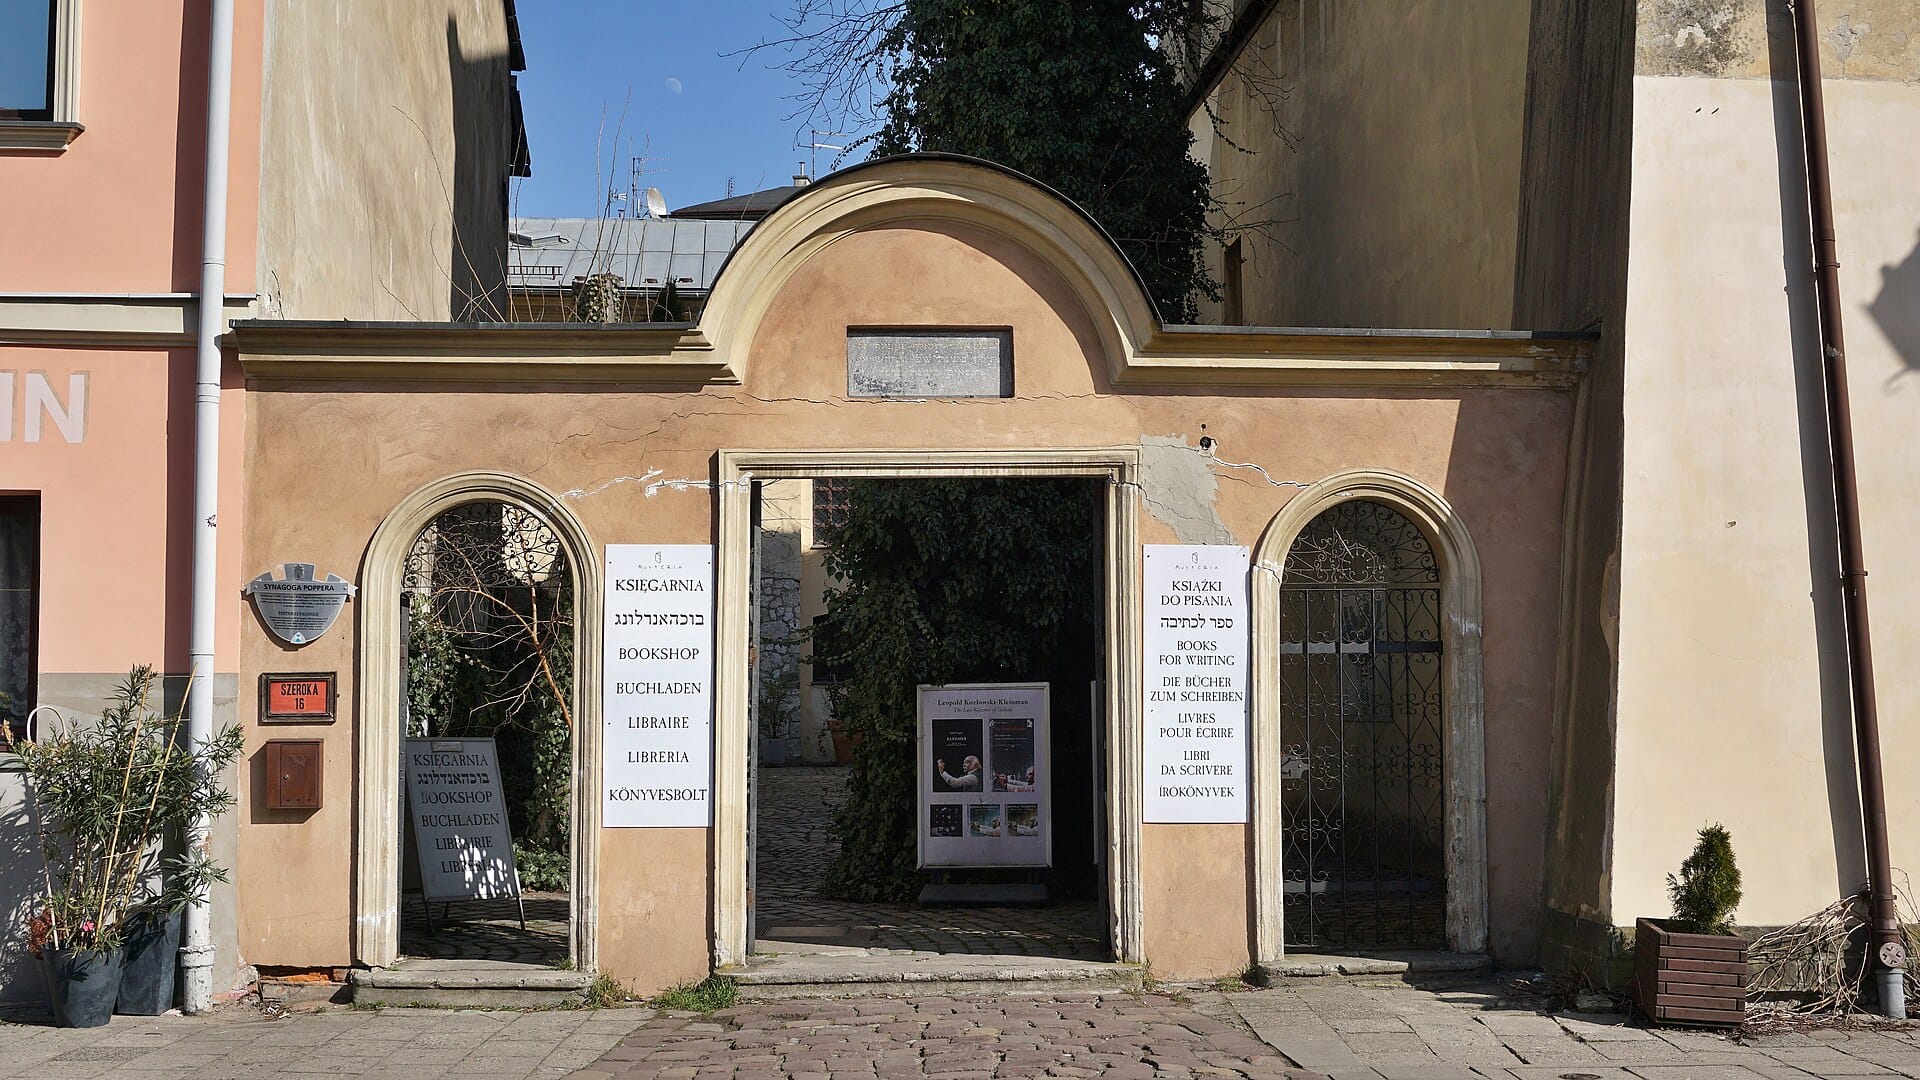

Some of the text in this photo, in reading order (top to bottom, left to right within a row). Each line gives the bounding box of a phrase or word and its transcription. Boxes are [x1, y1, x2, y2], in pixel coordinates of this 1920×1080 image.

[263, 583, 302, 591] SYNAGOGA
[615, 579, 704, 593] KSIĘGARNIA
[1172, 578, 1222, 593] KSIĄŻKI
[1161, 595, 1232, 606] DO PISANIA
[1160, 613, 1233, 628] ספר לכתיבה
[1177, 640, 1217, 651] BOOKS
[619, 647, 699, 660] BOOKSHOP
[1159, 655, 1235, 665] FOR WRITING
[1163, 674, 1232, 687] DIE BÜCHER
[280, 683, 319, 696] SZEROKA
[616, 682, 701, 694] BUCHLADEN
[1150, 691, 1243, 702] ZUM SCHREIBEN
[294, 697, 305, 710] 16
[937, 699, 962, 707] Leopold
[628, 716, 689, 728] LIBRAIRE
[1178, 713, 1216, 723] LIVRES
[1159, 726, 1234, 738] POUR ÉCRIRE
[413, 754, 489, 768] KSIĘGARNIA
[628, 751, 689, 763] LIBRERIA
[1183, 750, 1210, 761] LIBRI
[1161, 764, 1233, 775] DA SCRIVERE
[421, 790, 493, 804] BOOKSHOP
[609, 786, 707, 801] KÖNYVESBOLT
[421, 813, 500, 827] BUCHLADEN
[435, 836, 493, 850] LIBRAIRIE
